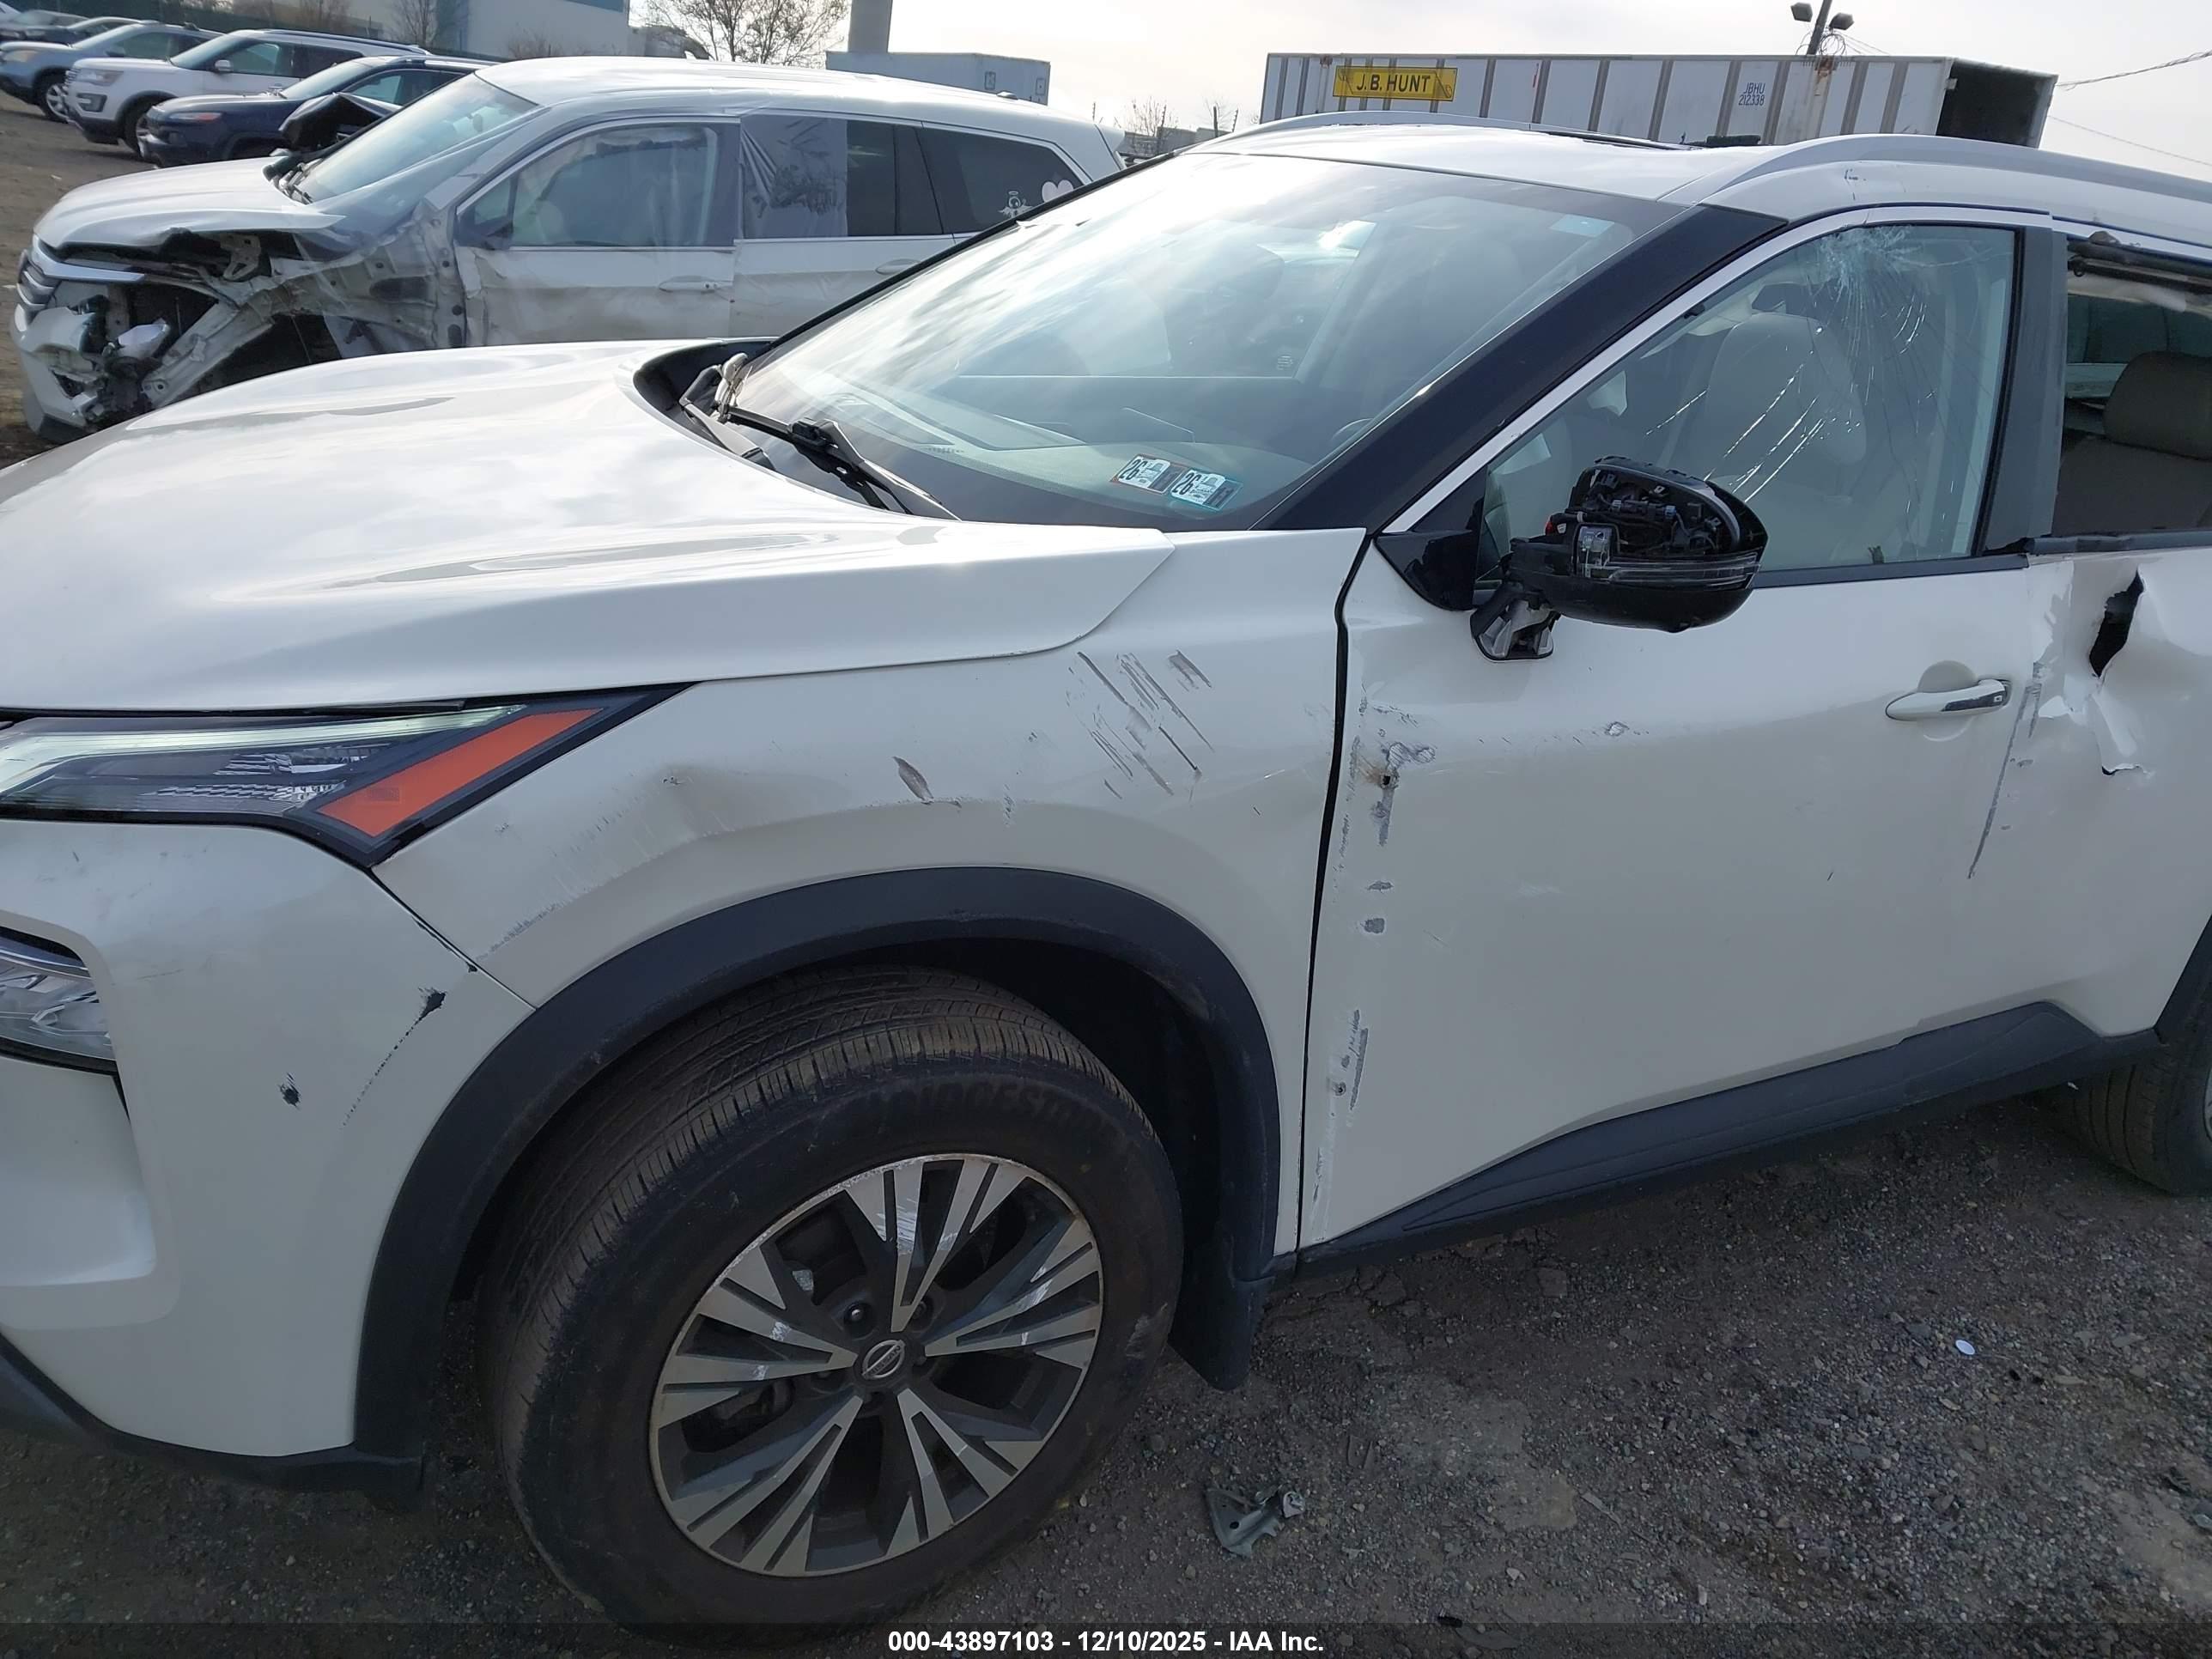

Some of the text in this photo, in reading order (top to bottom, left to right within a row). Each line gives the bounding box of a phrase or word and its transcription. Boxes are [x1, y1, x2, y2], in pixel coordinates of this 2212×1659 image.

[1386, 74, 1431, 93] HUNT
[1743, 82, 1765, 94] JBHU
[1738, 94, 1765, 106] 212338
[1118, 459, 1148, 480] 26
[1171, 471, 1202, 495] 26
